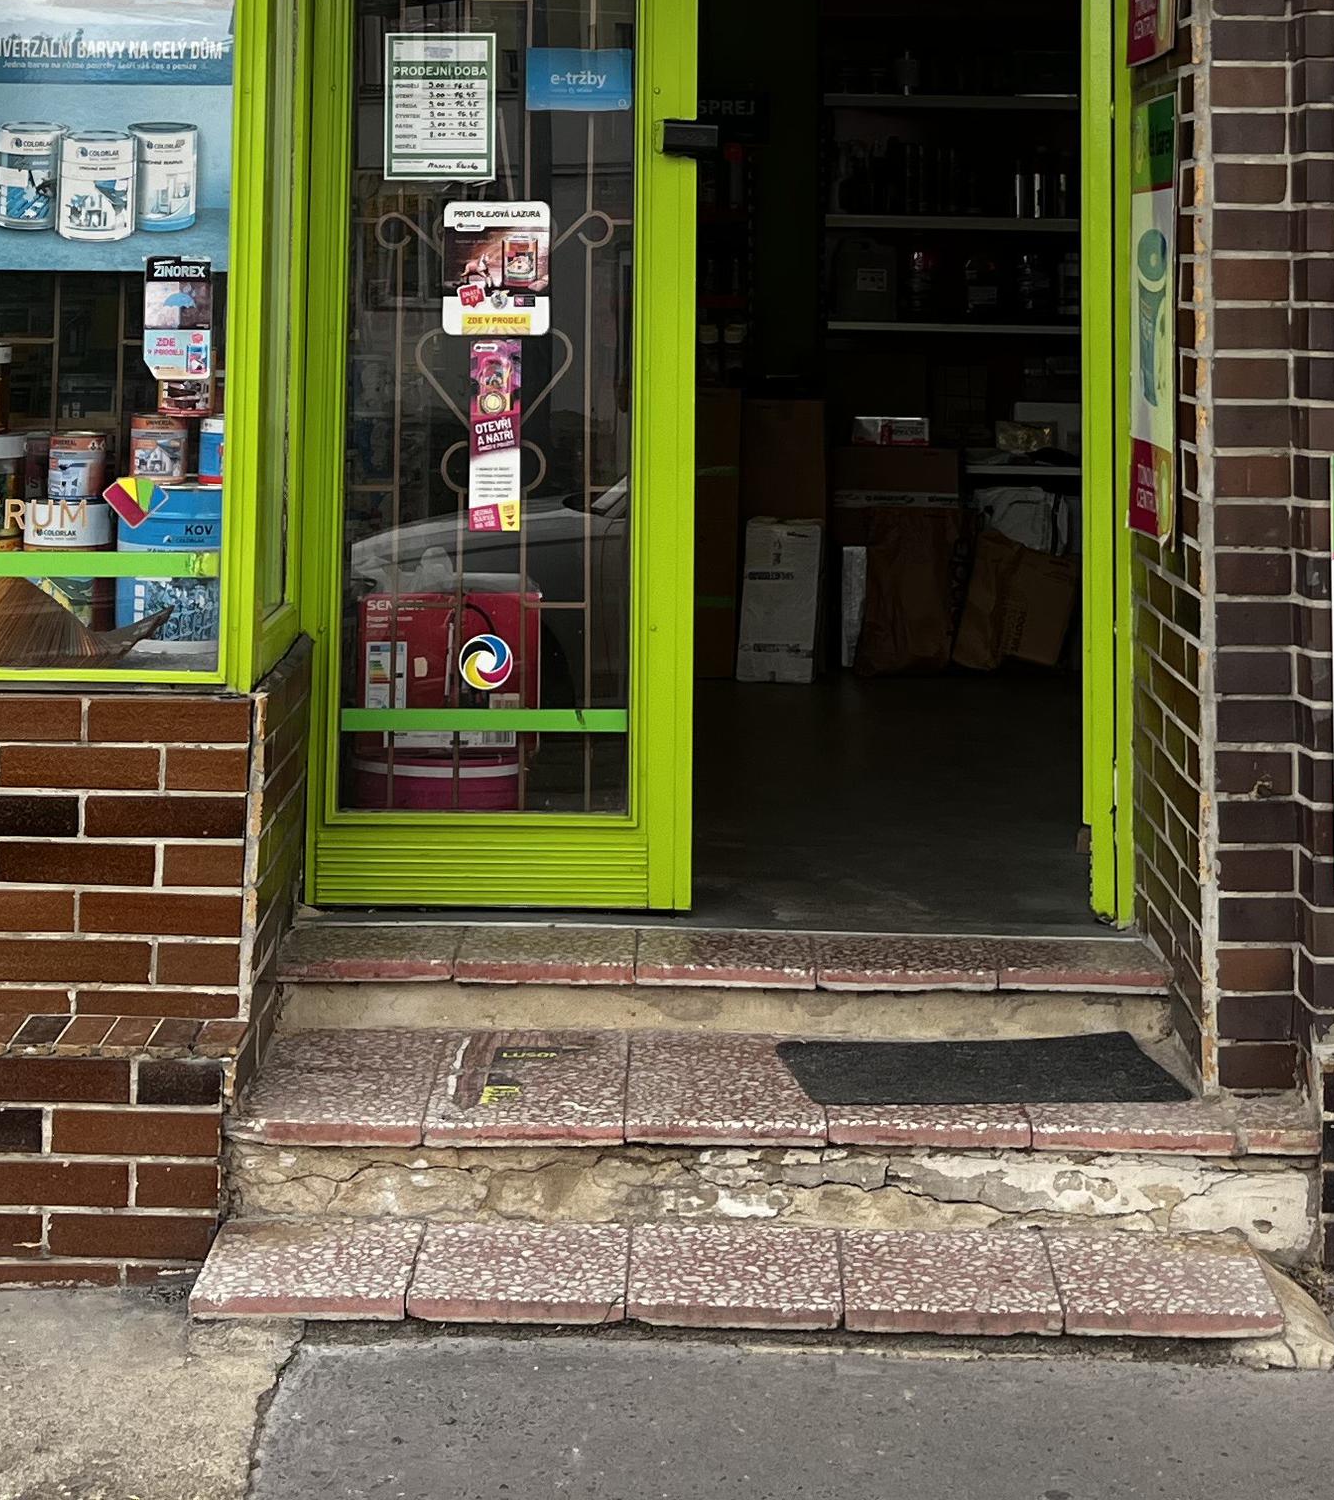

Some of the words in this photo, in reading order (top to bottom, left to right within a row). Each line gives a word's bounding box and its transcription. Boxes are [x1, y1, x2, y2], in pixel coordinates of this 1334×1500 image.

[77, 39, 126, 59] BARVY
[128, 41, 149, 59] NA
[153, 37, 187, 60] CELÝ
[190, 37, 223, 60] DŮM
[393, 65, 451, 76] PRODEJNÍ
[454, 66, 488, 76] DOBA
[550, 70, 607, 88] e-tržby
[154, 265, 206, 278] ZINOREX
[474, 416, 512, 434] OTEVŘI
[477, 436, 485, 446] A
[486, 429, 514, 443] NATŘI
[184, 524, 214, 536] KOV
